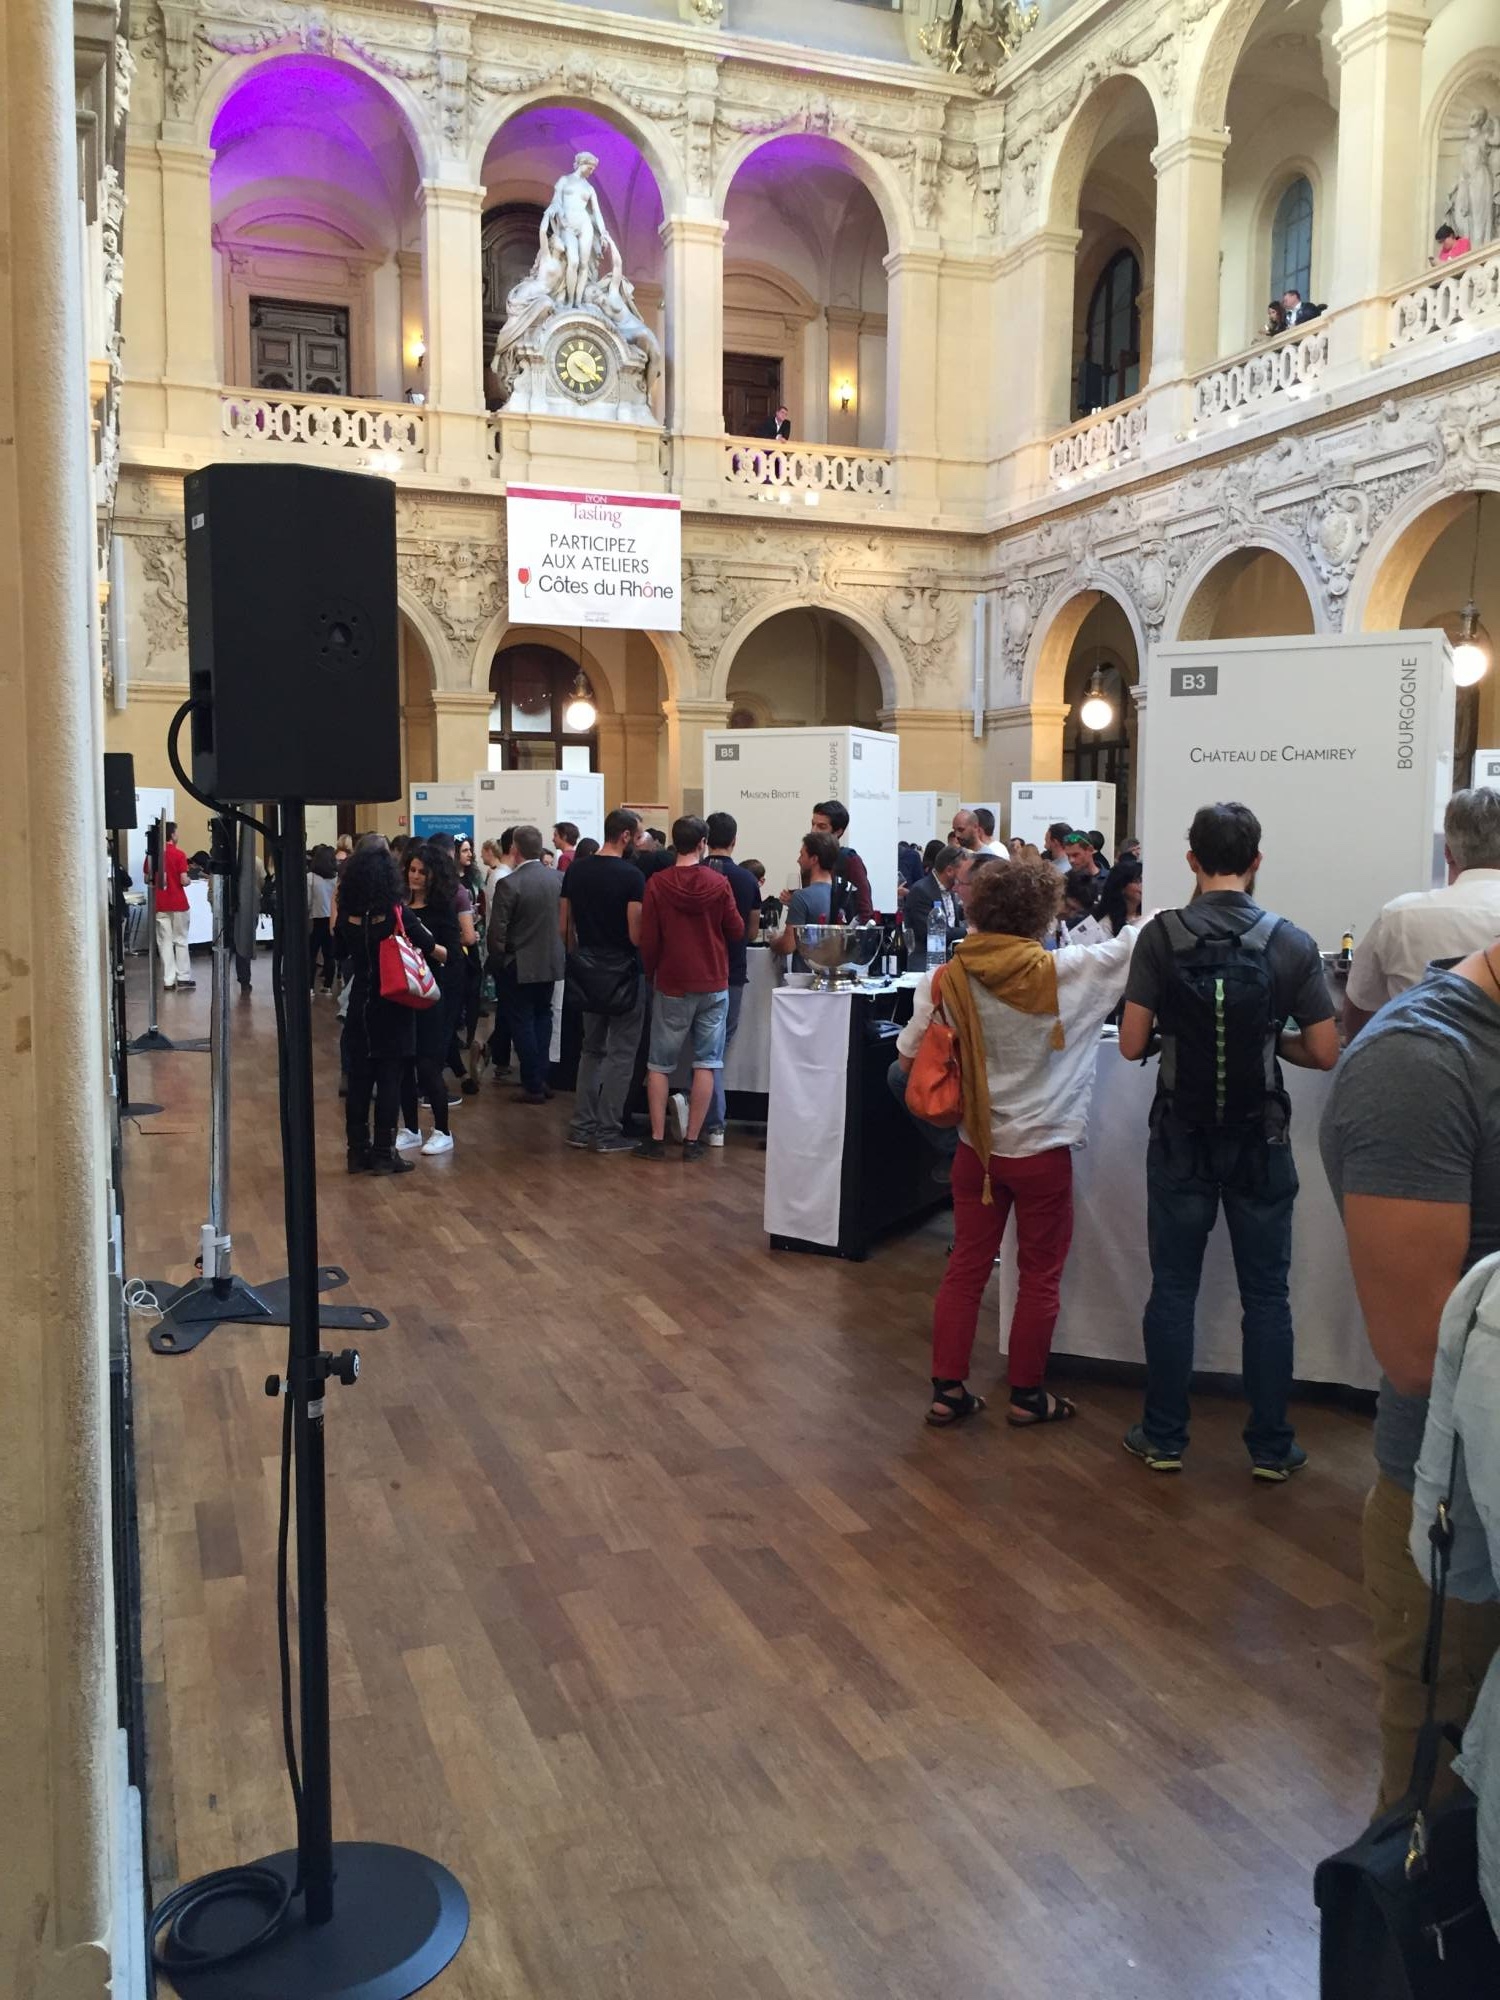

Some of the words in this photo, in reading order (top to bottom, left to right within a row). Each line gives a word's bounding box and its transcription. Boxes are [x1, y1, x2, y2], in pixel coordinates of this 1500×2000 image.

[585, 494, 608, 503] LYON
[570, 502, 622, 528] Tasting
[550, 533, 636, 553] PARTICIPEZ
[541, 553, 576, 569] AUX
[581, 556, 649, 574] ATELIERS
[539, 575, 589, 594] Côtes
[594, 579, 616, 595] du
[620, 580, 673, 599] Rhône
[1182, 674, 1206, 690] B3
[1397, 657, 1418, 769] BOURGOGNE
[721, 748, 734, 757] B5
